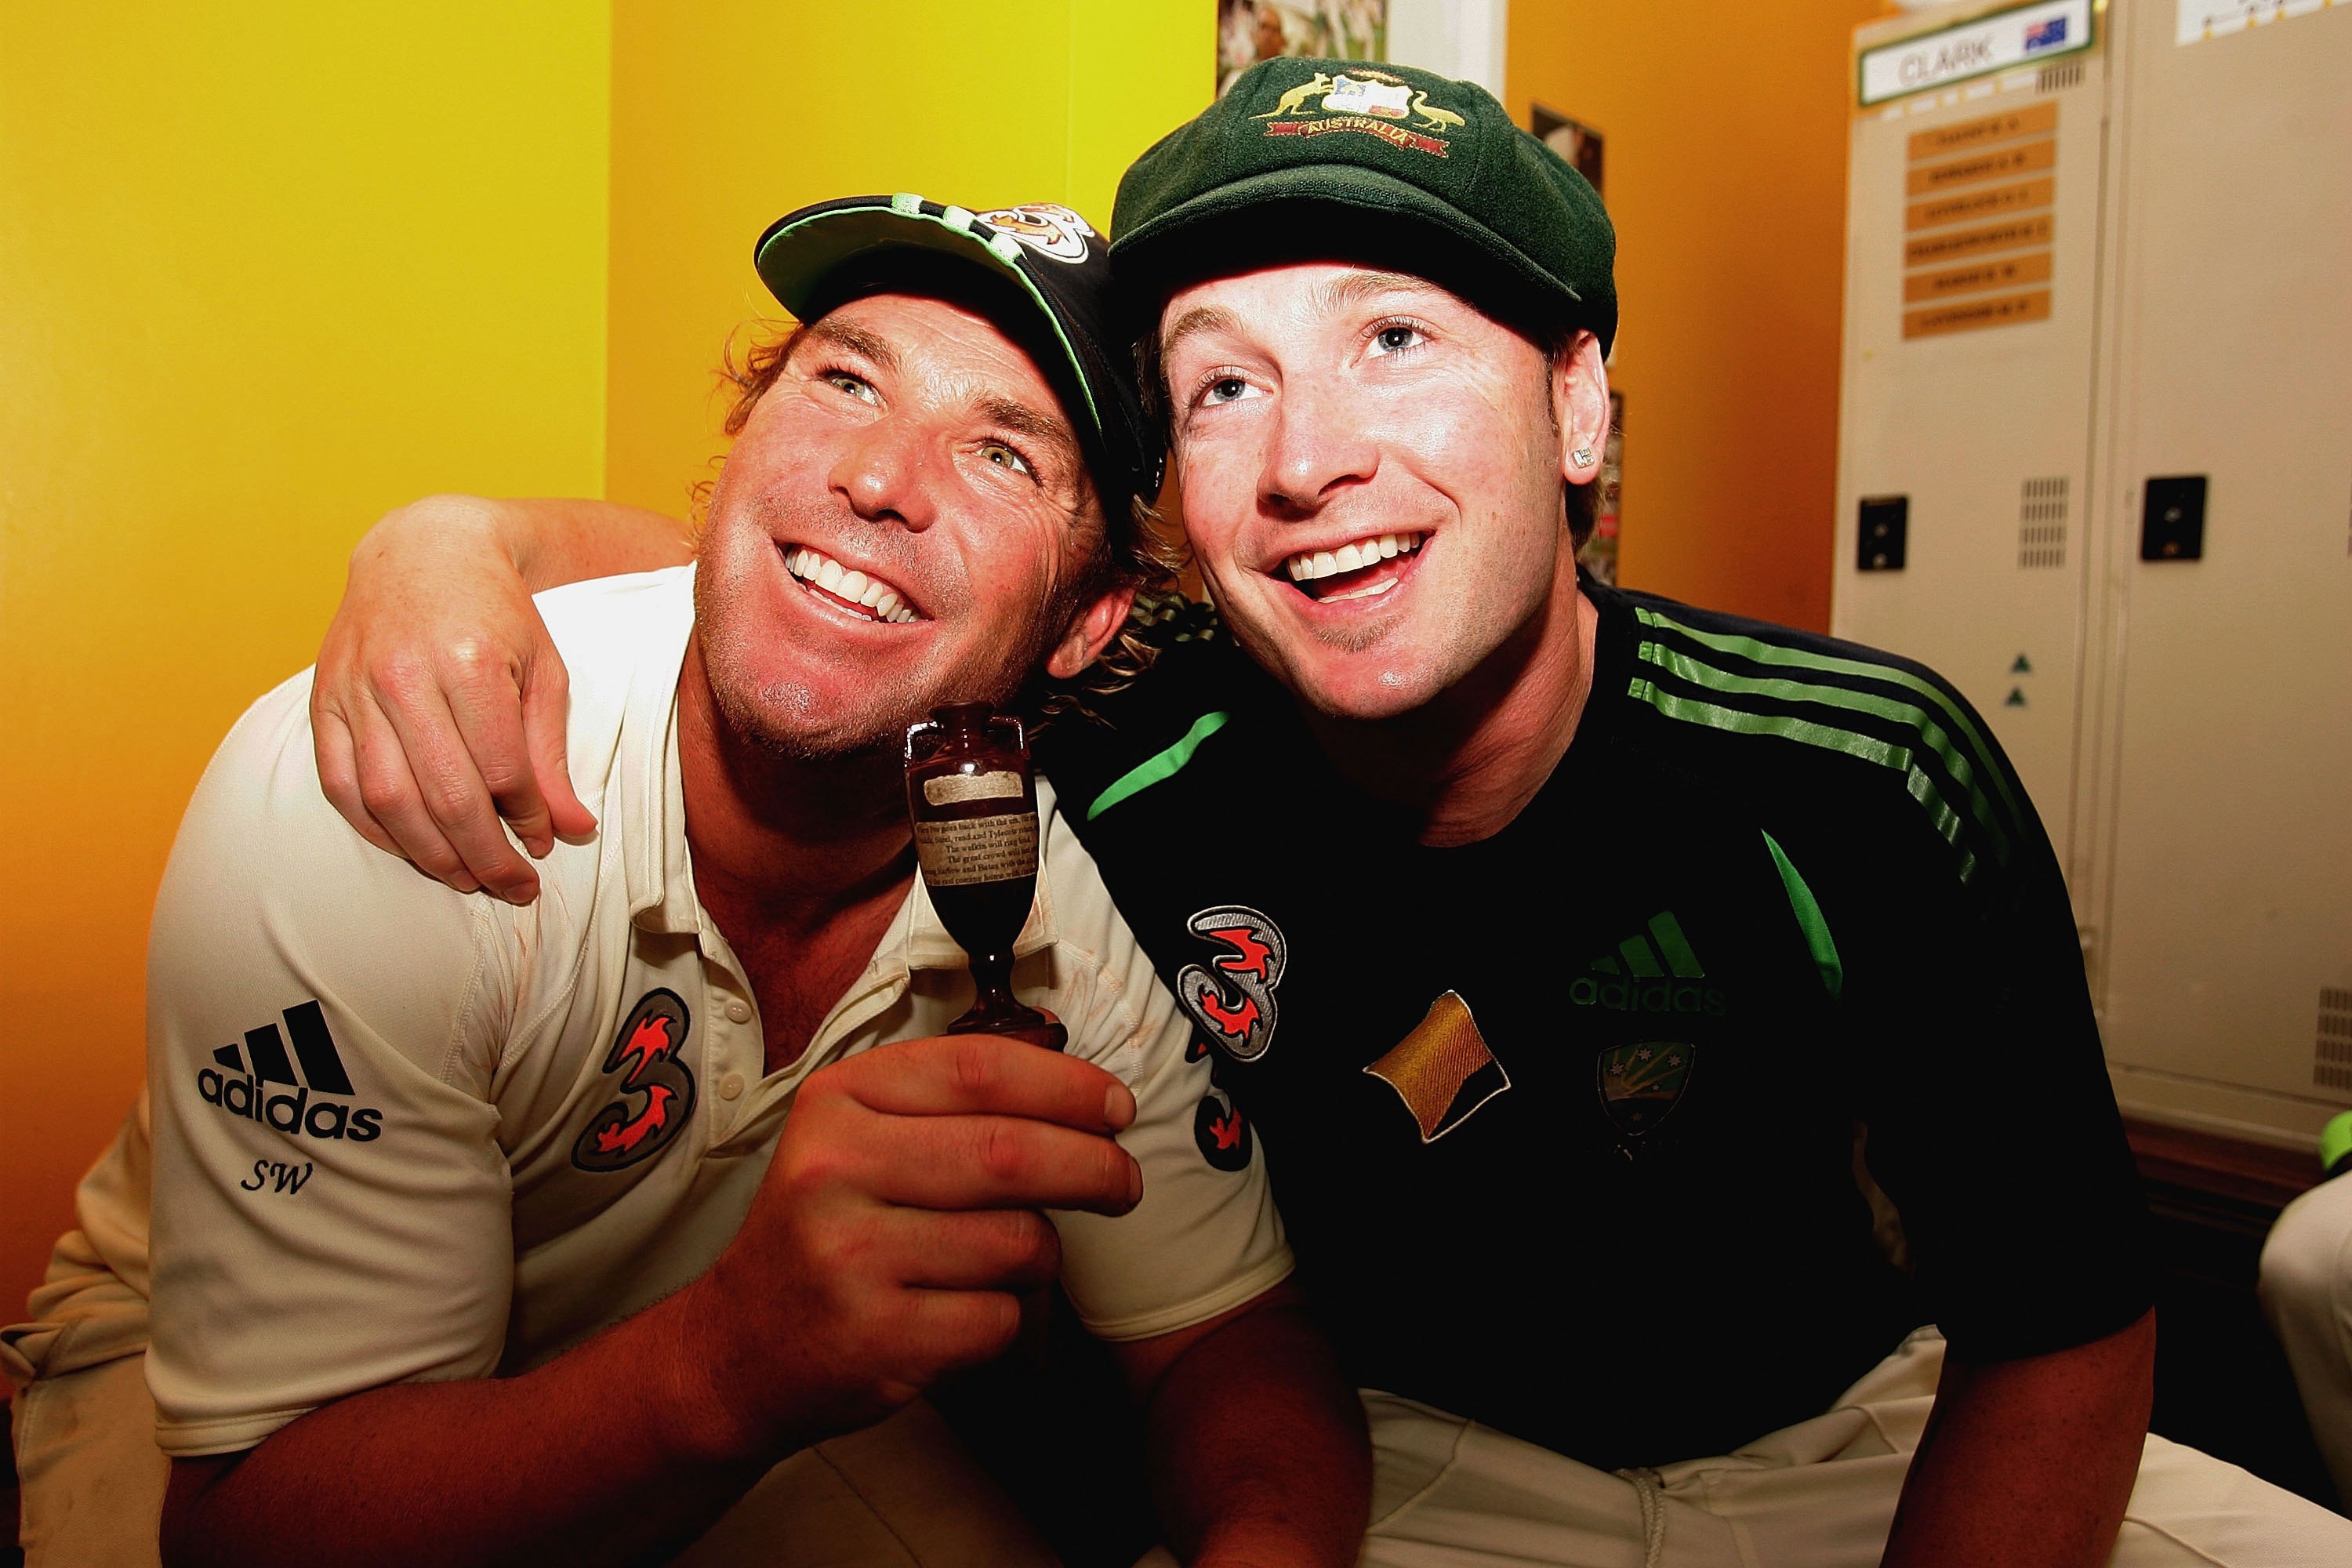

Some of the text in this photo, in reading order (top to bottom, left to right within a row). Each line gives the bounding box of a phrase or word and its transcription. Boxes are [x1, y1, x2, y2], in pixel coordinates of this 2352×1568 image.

[1898, 34, 1993, 86] CLARK
[1307, 117, 1407, 145] AUSTRALIA
[972, 832, 986, 840] and
[978, 819, 995, 828] with
[946, 845, 960, 854] The
[988, 840, 1003, 849] will
[947, 855, 960, 864] The
[982, 850, 1006, 861] crowd
[962, 865, 976, 873] and
[1567, 975, 1731, 1017] adidas
[571, 987, 698, 1173] 3
[197, 1063, 384, 1143] adidas
[240, 1160, 314, 1196] SW
